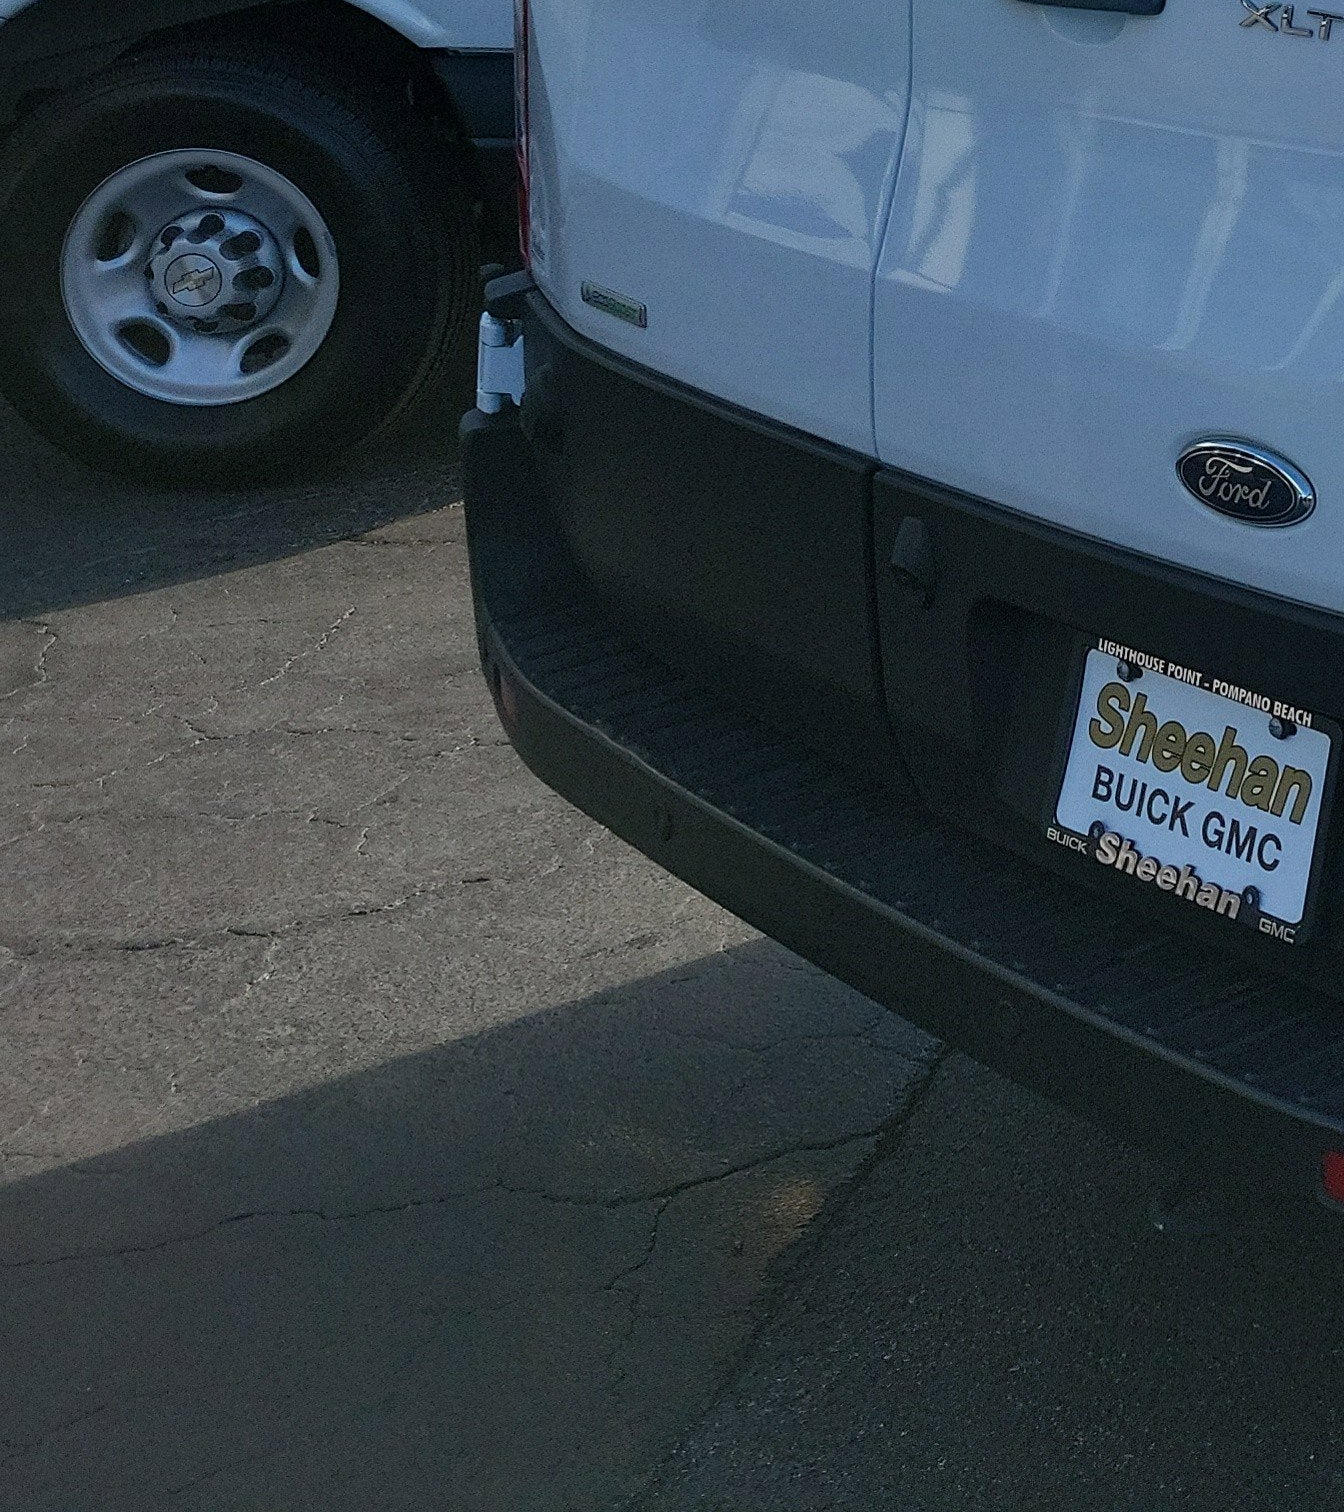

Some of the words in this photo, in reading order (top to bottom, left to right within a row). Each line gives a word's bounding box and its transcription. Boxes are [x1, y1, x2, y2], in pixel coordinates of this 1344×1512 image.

[1198, 456, 1273, 510] Ford
[1098, 638, 1165, 674] LIGHTHOUSE
[1167, 663, 1203, 687] POINT
[1212, 678, 1271, 712] POMPANO
[1273, 701, 1312, 727] BEACH
[1088, 681, 1313, 825] Sheehan
[1046, 826, 1088, 855] BUICK
[1091, 764, 1196, 838] BUICK
[1201, 811, 1282, 872] GMC
[1095, 831, 1242, 920] Sheehan
[1258, 918, 1296, 944] GMC
